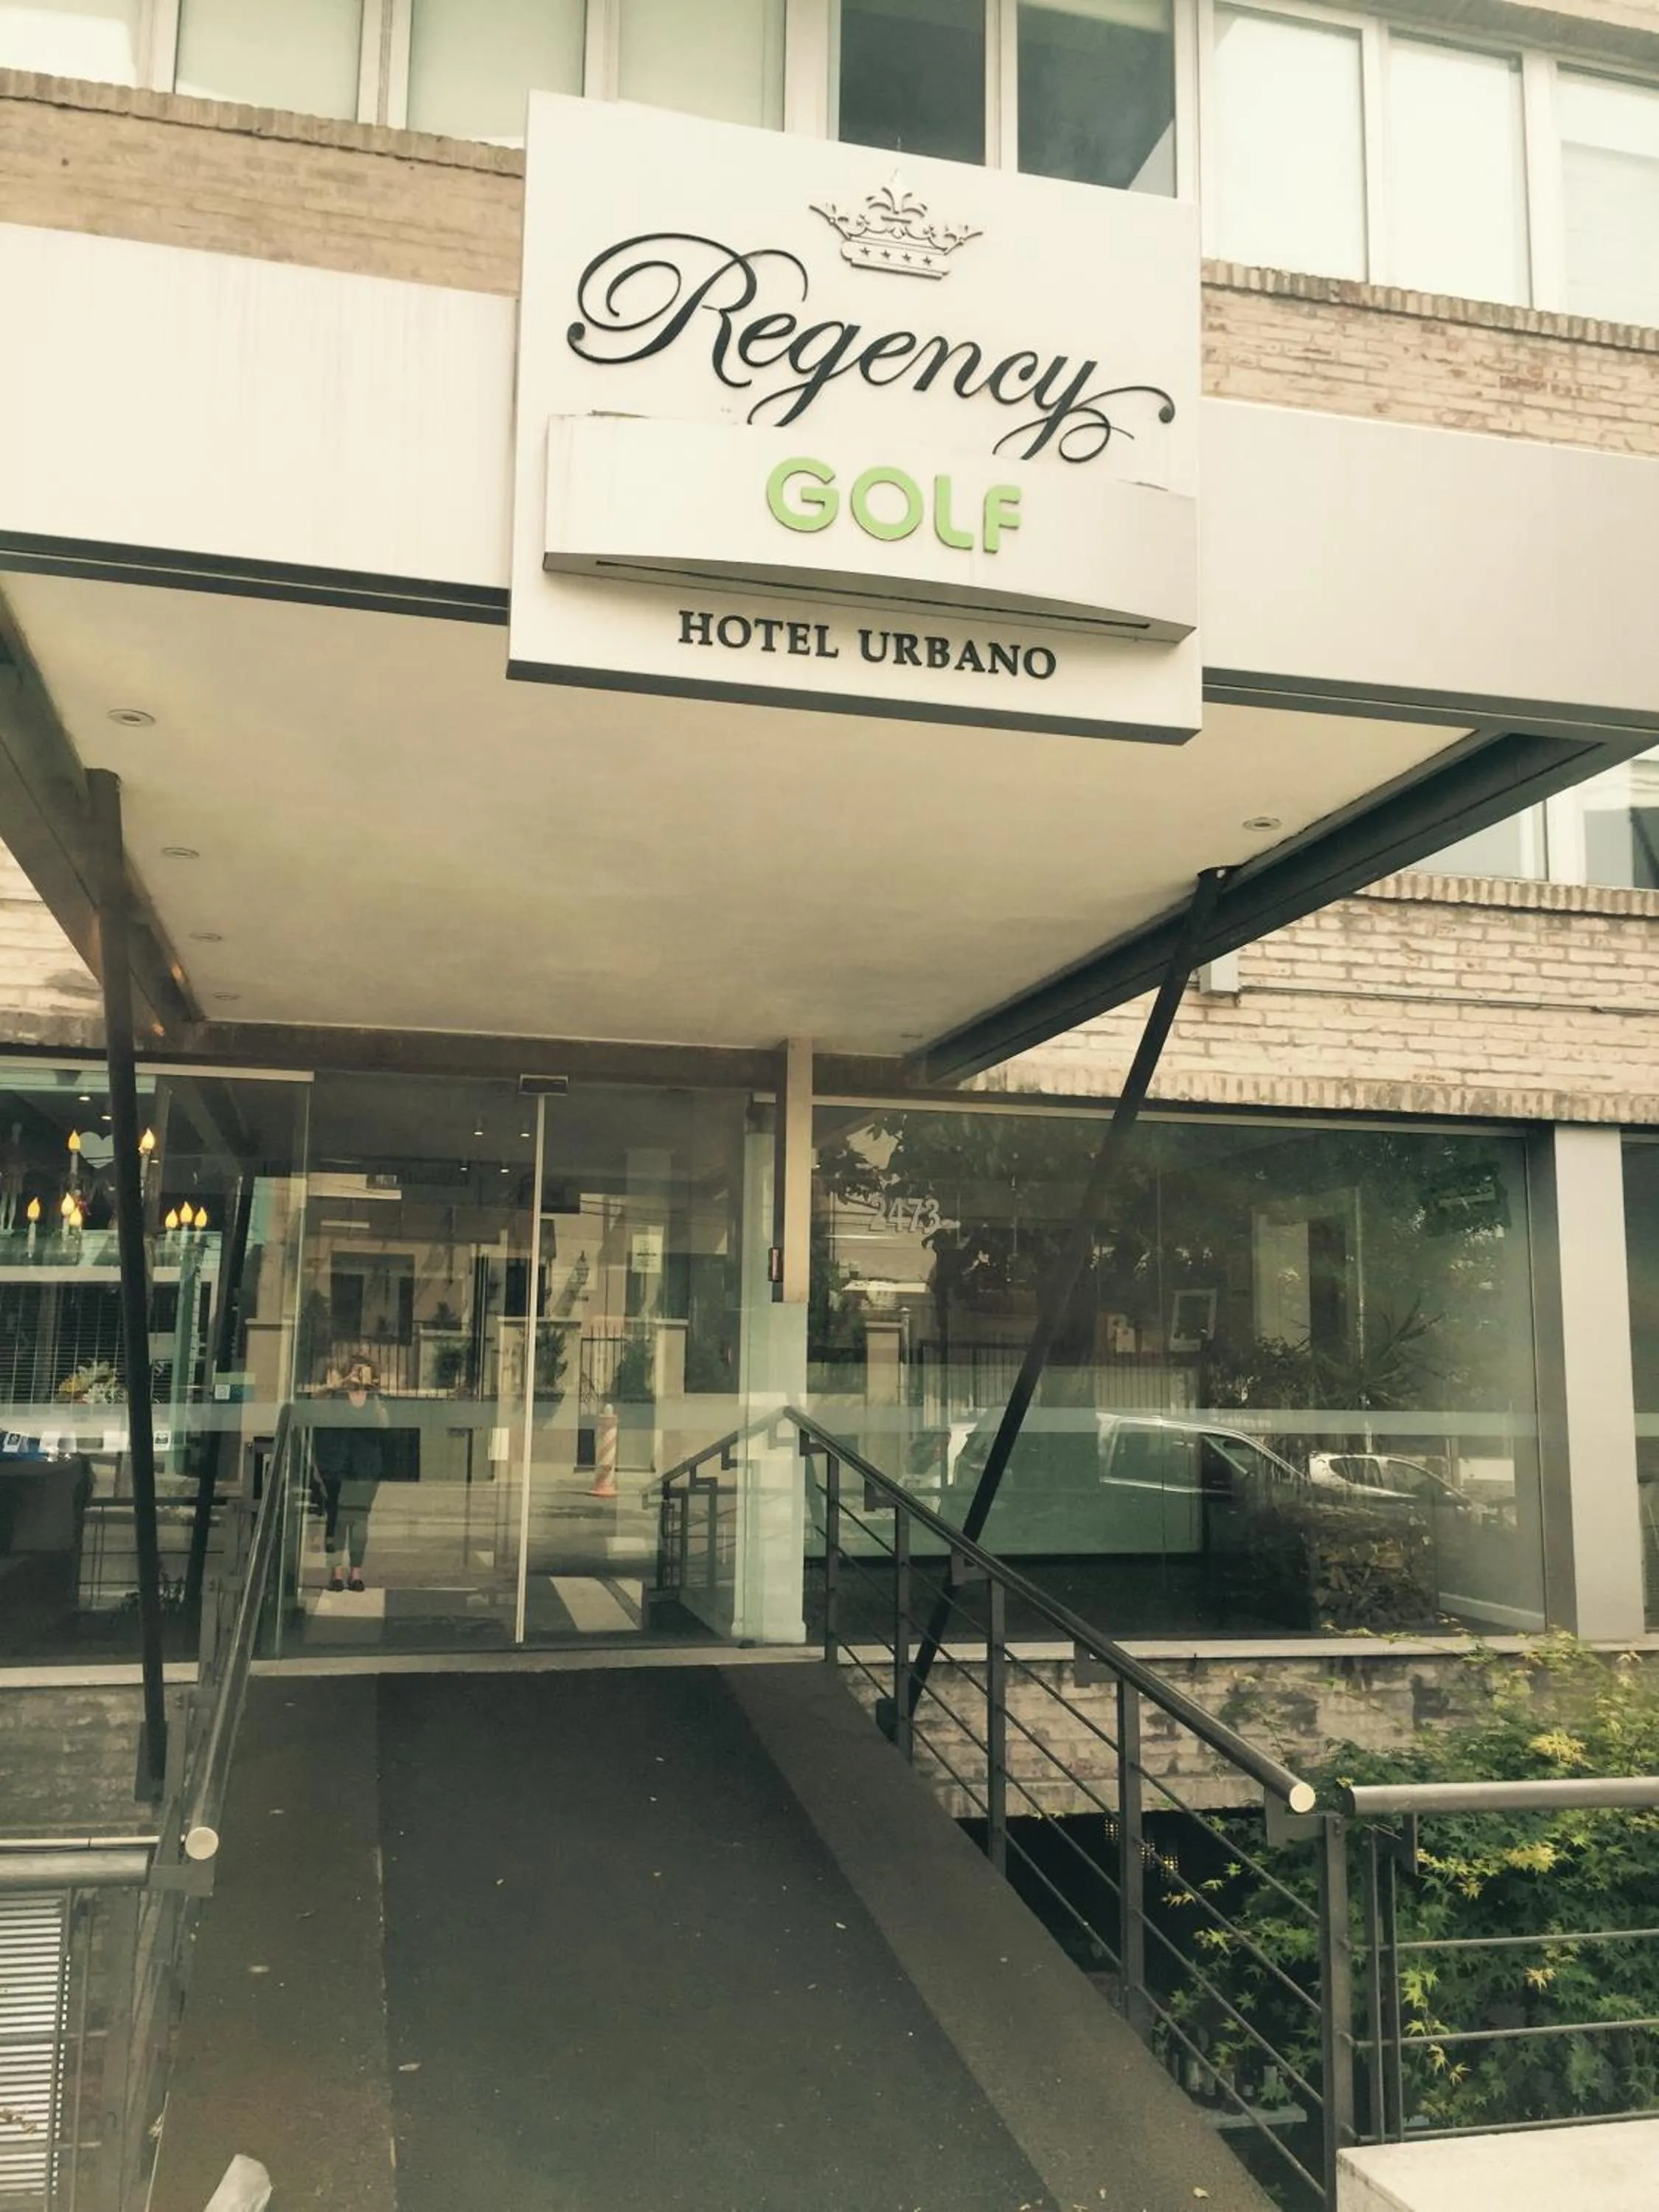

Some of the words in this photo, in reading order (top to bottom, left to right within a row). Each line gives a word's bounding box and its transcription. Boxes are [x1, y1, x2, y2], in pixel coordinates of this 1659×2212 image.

[568, 232, 1175, 463] Regency
[766, 457, 1022, 554] GOLF
[678, 611, 839, 658] HOTEL
[858, 629, 1057, 680] URBANO
[869, 1194, 941, 1234] 2473
